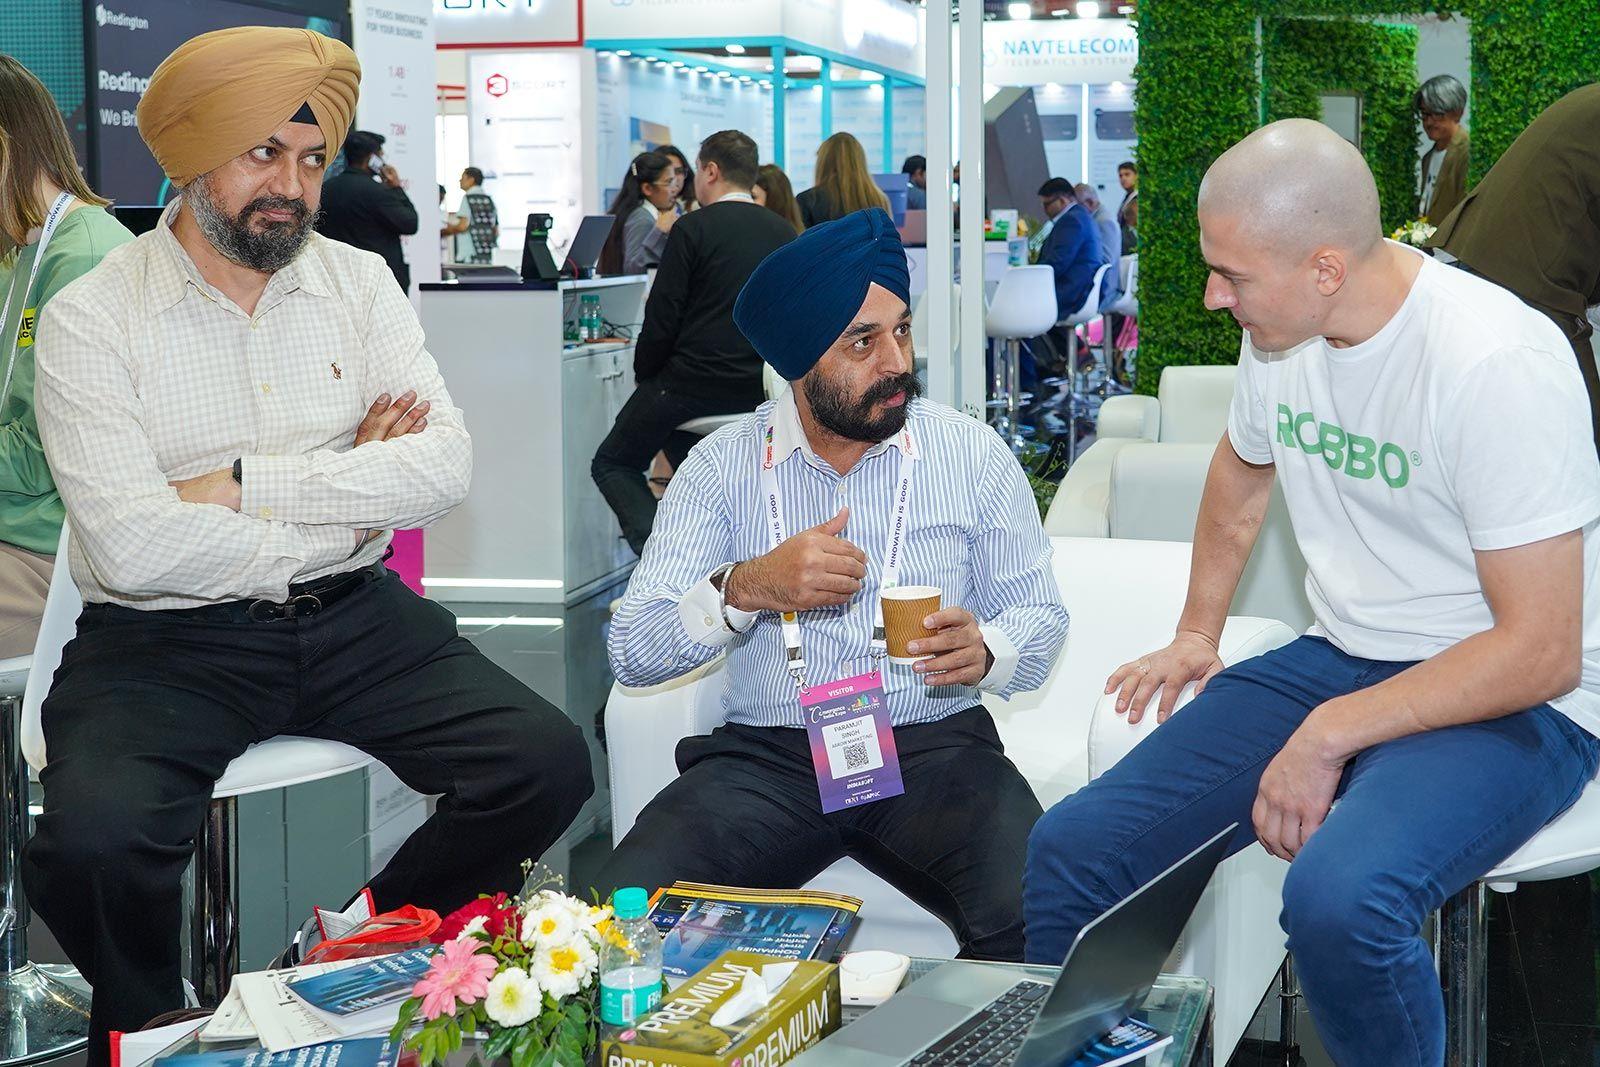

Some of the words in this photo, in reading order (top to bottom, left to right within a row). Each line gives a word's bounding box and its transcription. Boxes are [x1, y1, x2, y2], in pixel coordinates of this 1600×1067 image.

[106, 9, 149, 31] Redington
[1003, 38, 1135, 55] NAVTELECOM
[1005, 57, 1081, 67] TELEMATICS
[1083, 56, 1135, 66] SYSTEMS
[99, 108, 121, 126] We
[900, 478, 909, 503] GOOD
[769, 493, 779, 519] GOOD
[897, 504, 905, 515] IS
[889, 515, 903, 568] INNOVATION
[828, 685, 854, 698] VISITOR
[736, 946, 801, 956] COMPANIES
[636, 963, 753, 1034] PREMIUM
